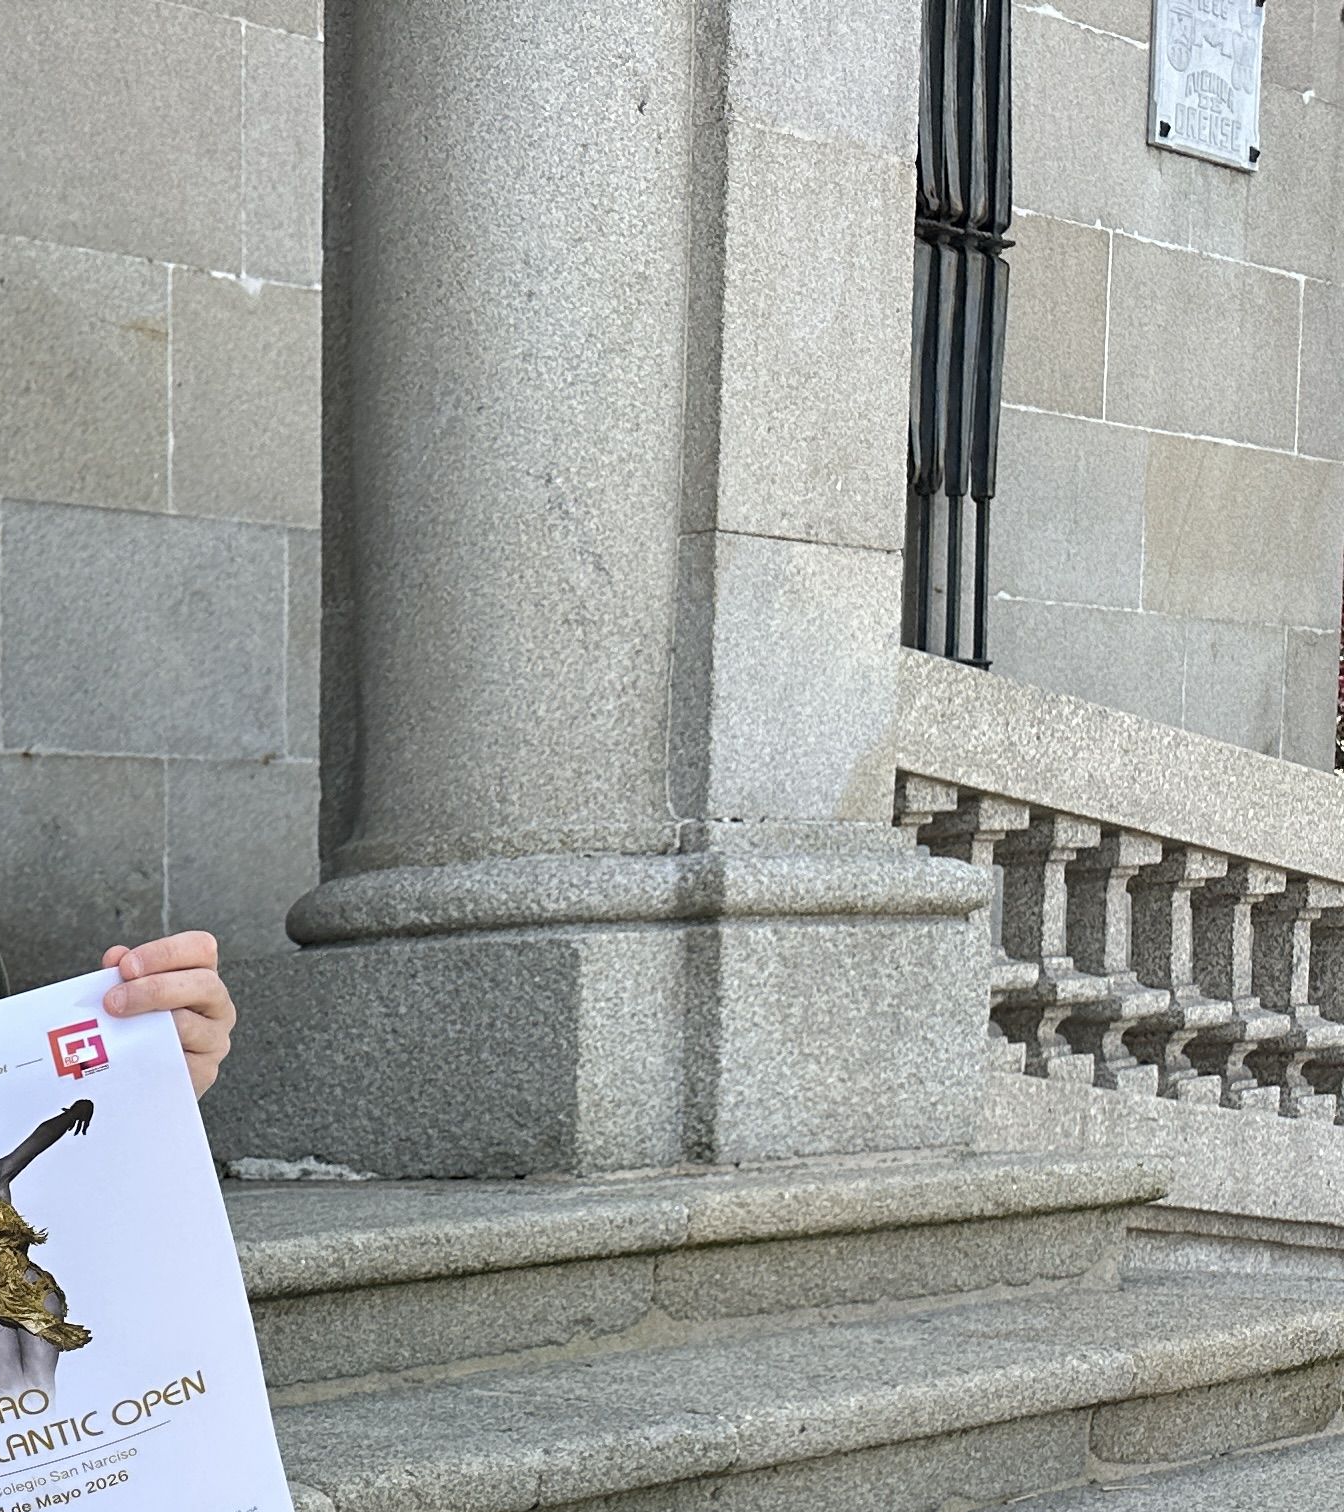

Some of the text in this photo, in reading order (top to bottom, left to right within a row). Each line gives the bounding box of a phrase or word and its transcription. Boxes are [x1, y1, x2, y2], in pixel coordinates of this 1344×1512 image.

[1174, 103, 1242, 152] ORENSE
[112, 1370, 206, 1426] OPEN
[49, 1467, 79, 1483] San
[81, 1447, 138, 1473] Narciso
[35, 1488, 81, 1510] Mayo
[85, 1470, 129, 1494] 2026
